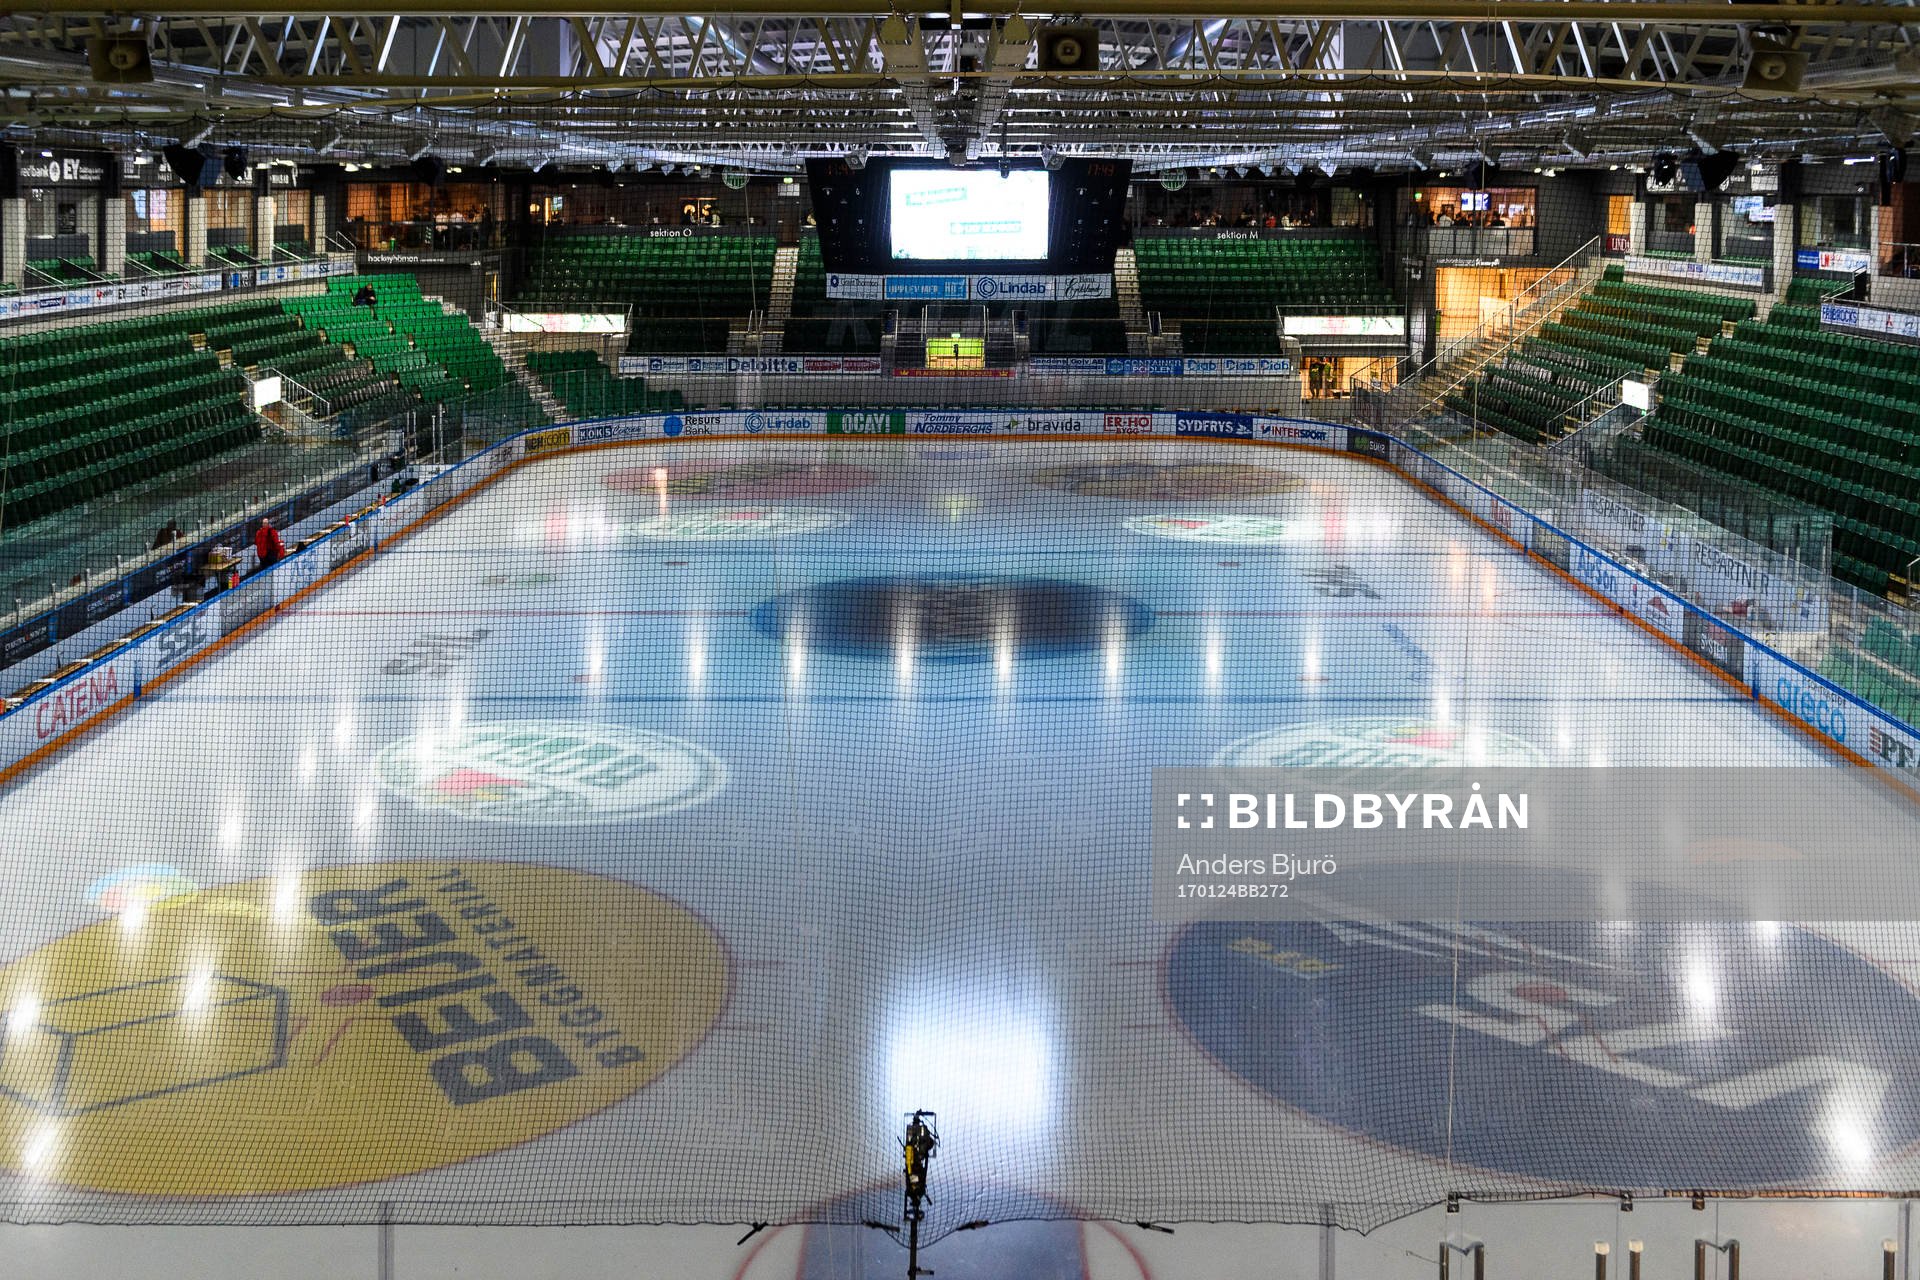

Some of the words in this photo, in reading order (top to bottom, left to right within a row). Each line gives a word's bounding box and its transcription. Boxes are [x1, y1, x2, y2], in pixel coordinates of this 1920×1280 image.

[64, 158, 80, 180] EY
[650, 227, 680, 238] sektion
[1217, 229, 1247, 240] sektion
[1249, 230, 1258, 240] M
[1000, 281, 1046, 294] Lindab
[685, 415, 721, 426] Resurs
[767, 416, 811, 429] Lindab
[924, 413, 961, 424] Tommy
[1027, 418, 1081, 432] bravida
[686, 426, 711, 436] Bank
[1177, 418, 1233, 433] SYDFRYS
[1271, 425, 1327, 441] INTERSPORT
[36, 665, 118, 740] CATENA
